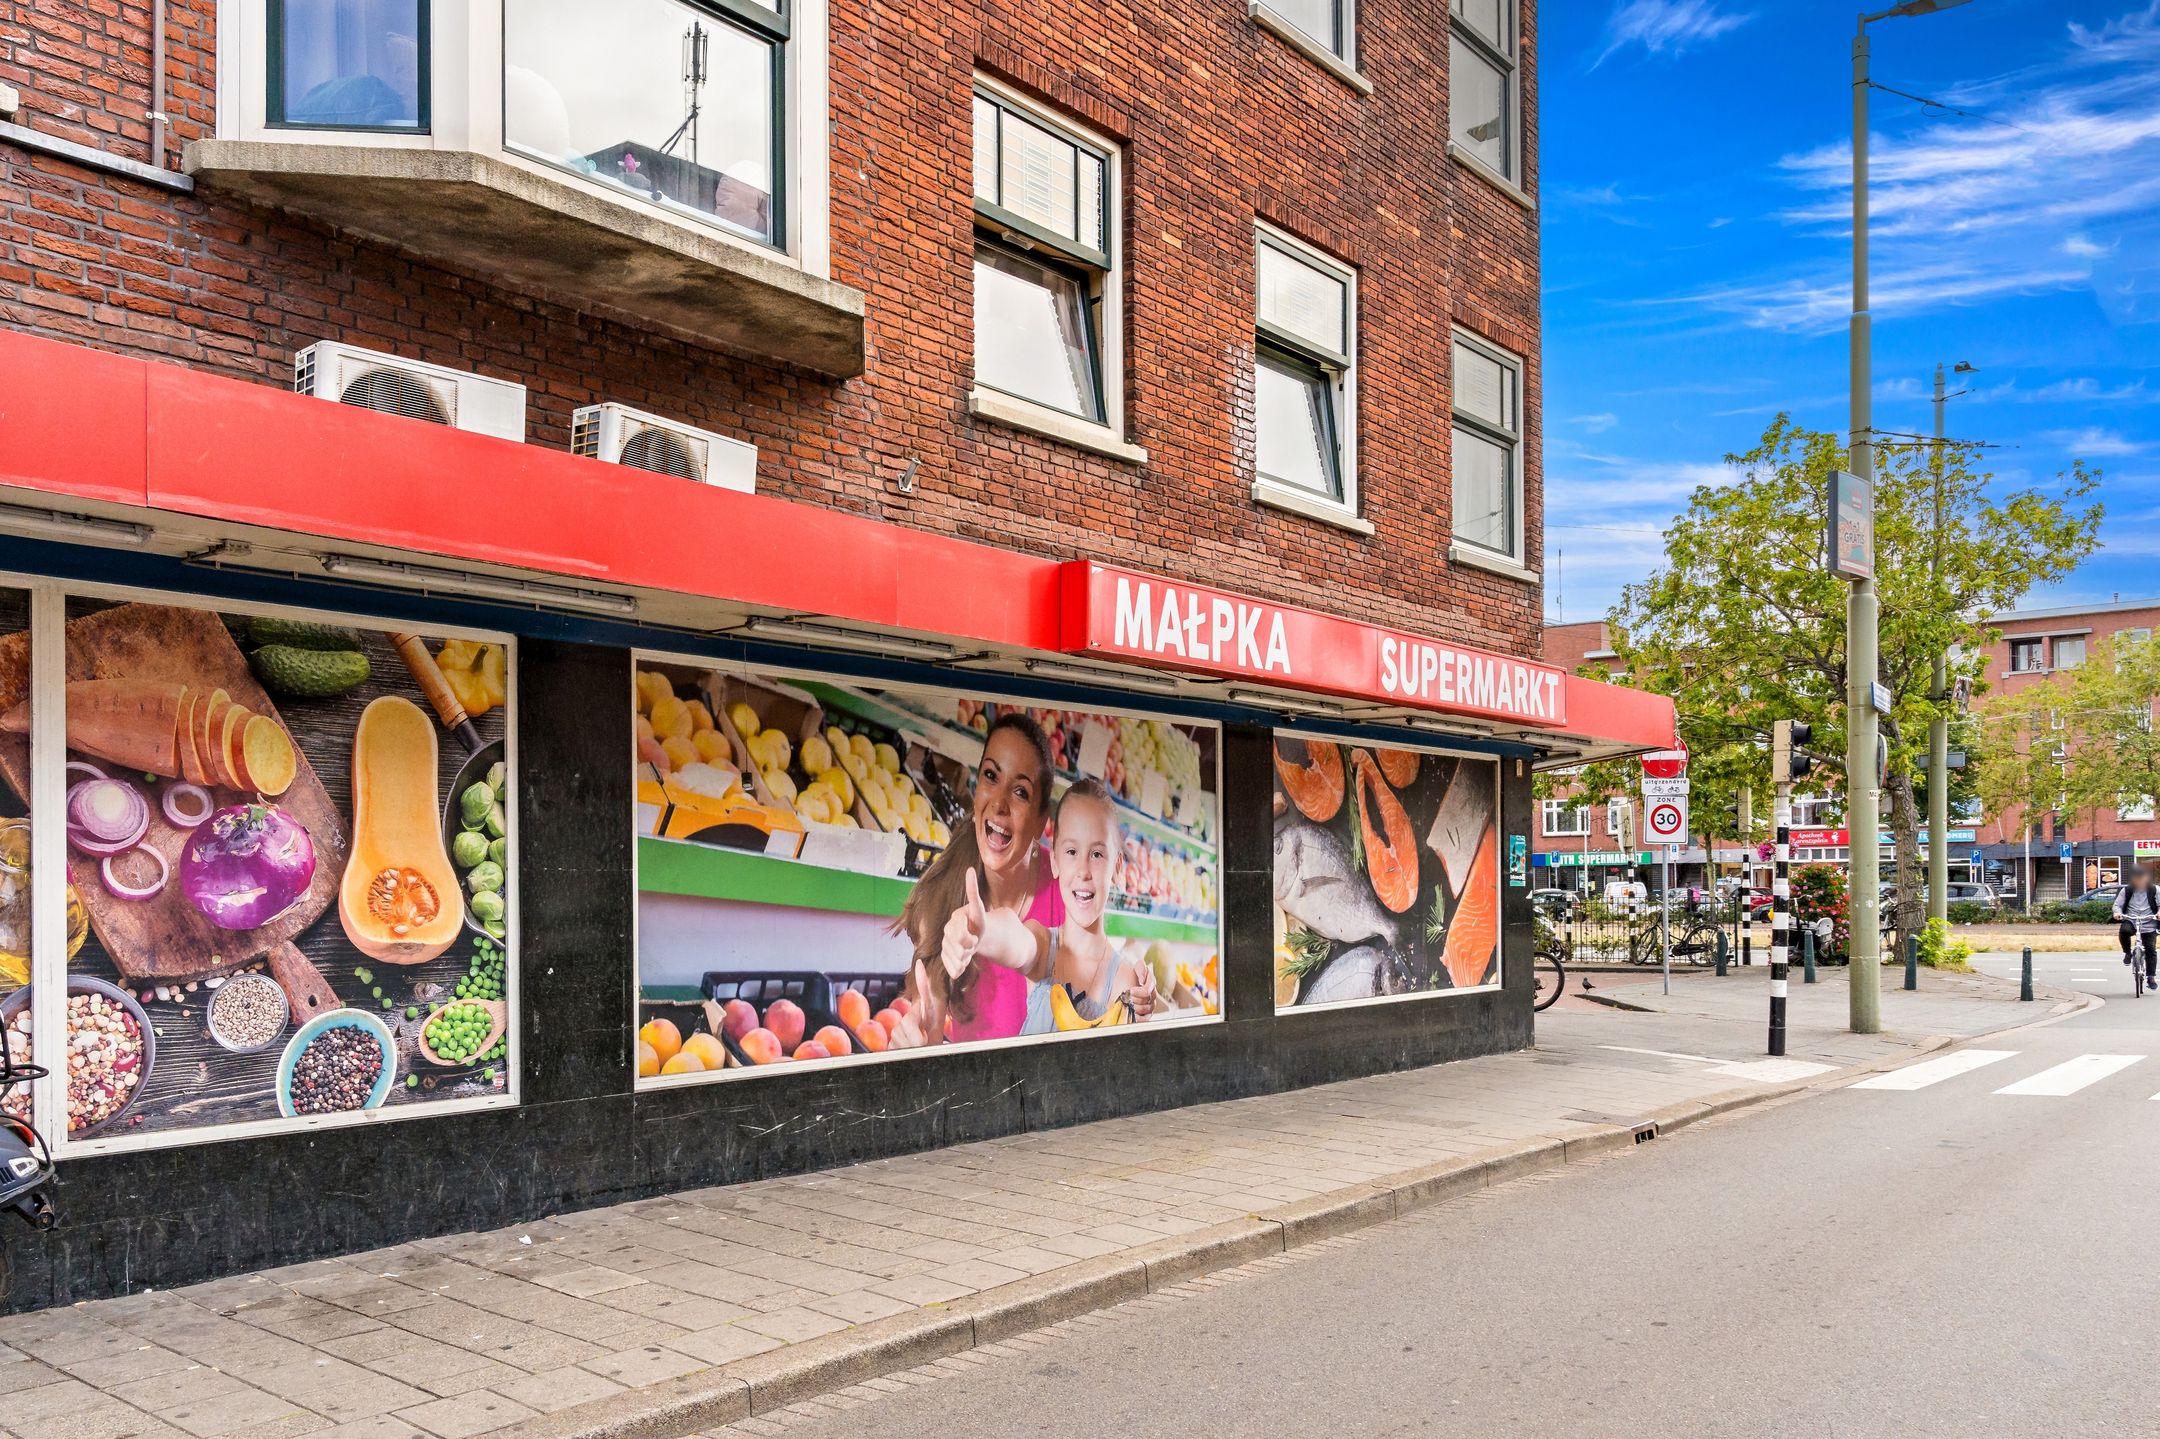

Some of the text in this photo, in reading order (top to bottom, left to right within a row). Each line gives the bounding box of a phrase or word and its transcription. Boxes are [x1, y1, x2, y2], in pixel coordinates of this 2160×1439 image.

[1114, 577, 1291, 674] MAŁPKA
[1381, 637, 1559, 719] SUPERMARKT
[1656, 813, 1677, 825] 30
[1946, 832, 1973, 840] OMERIJ
